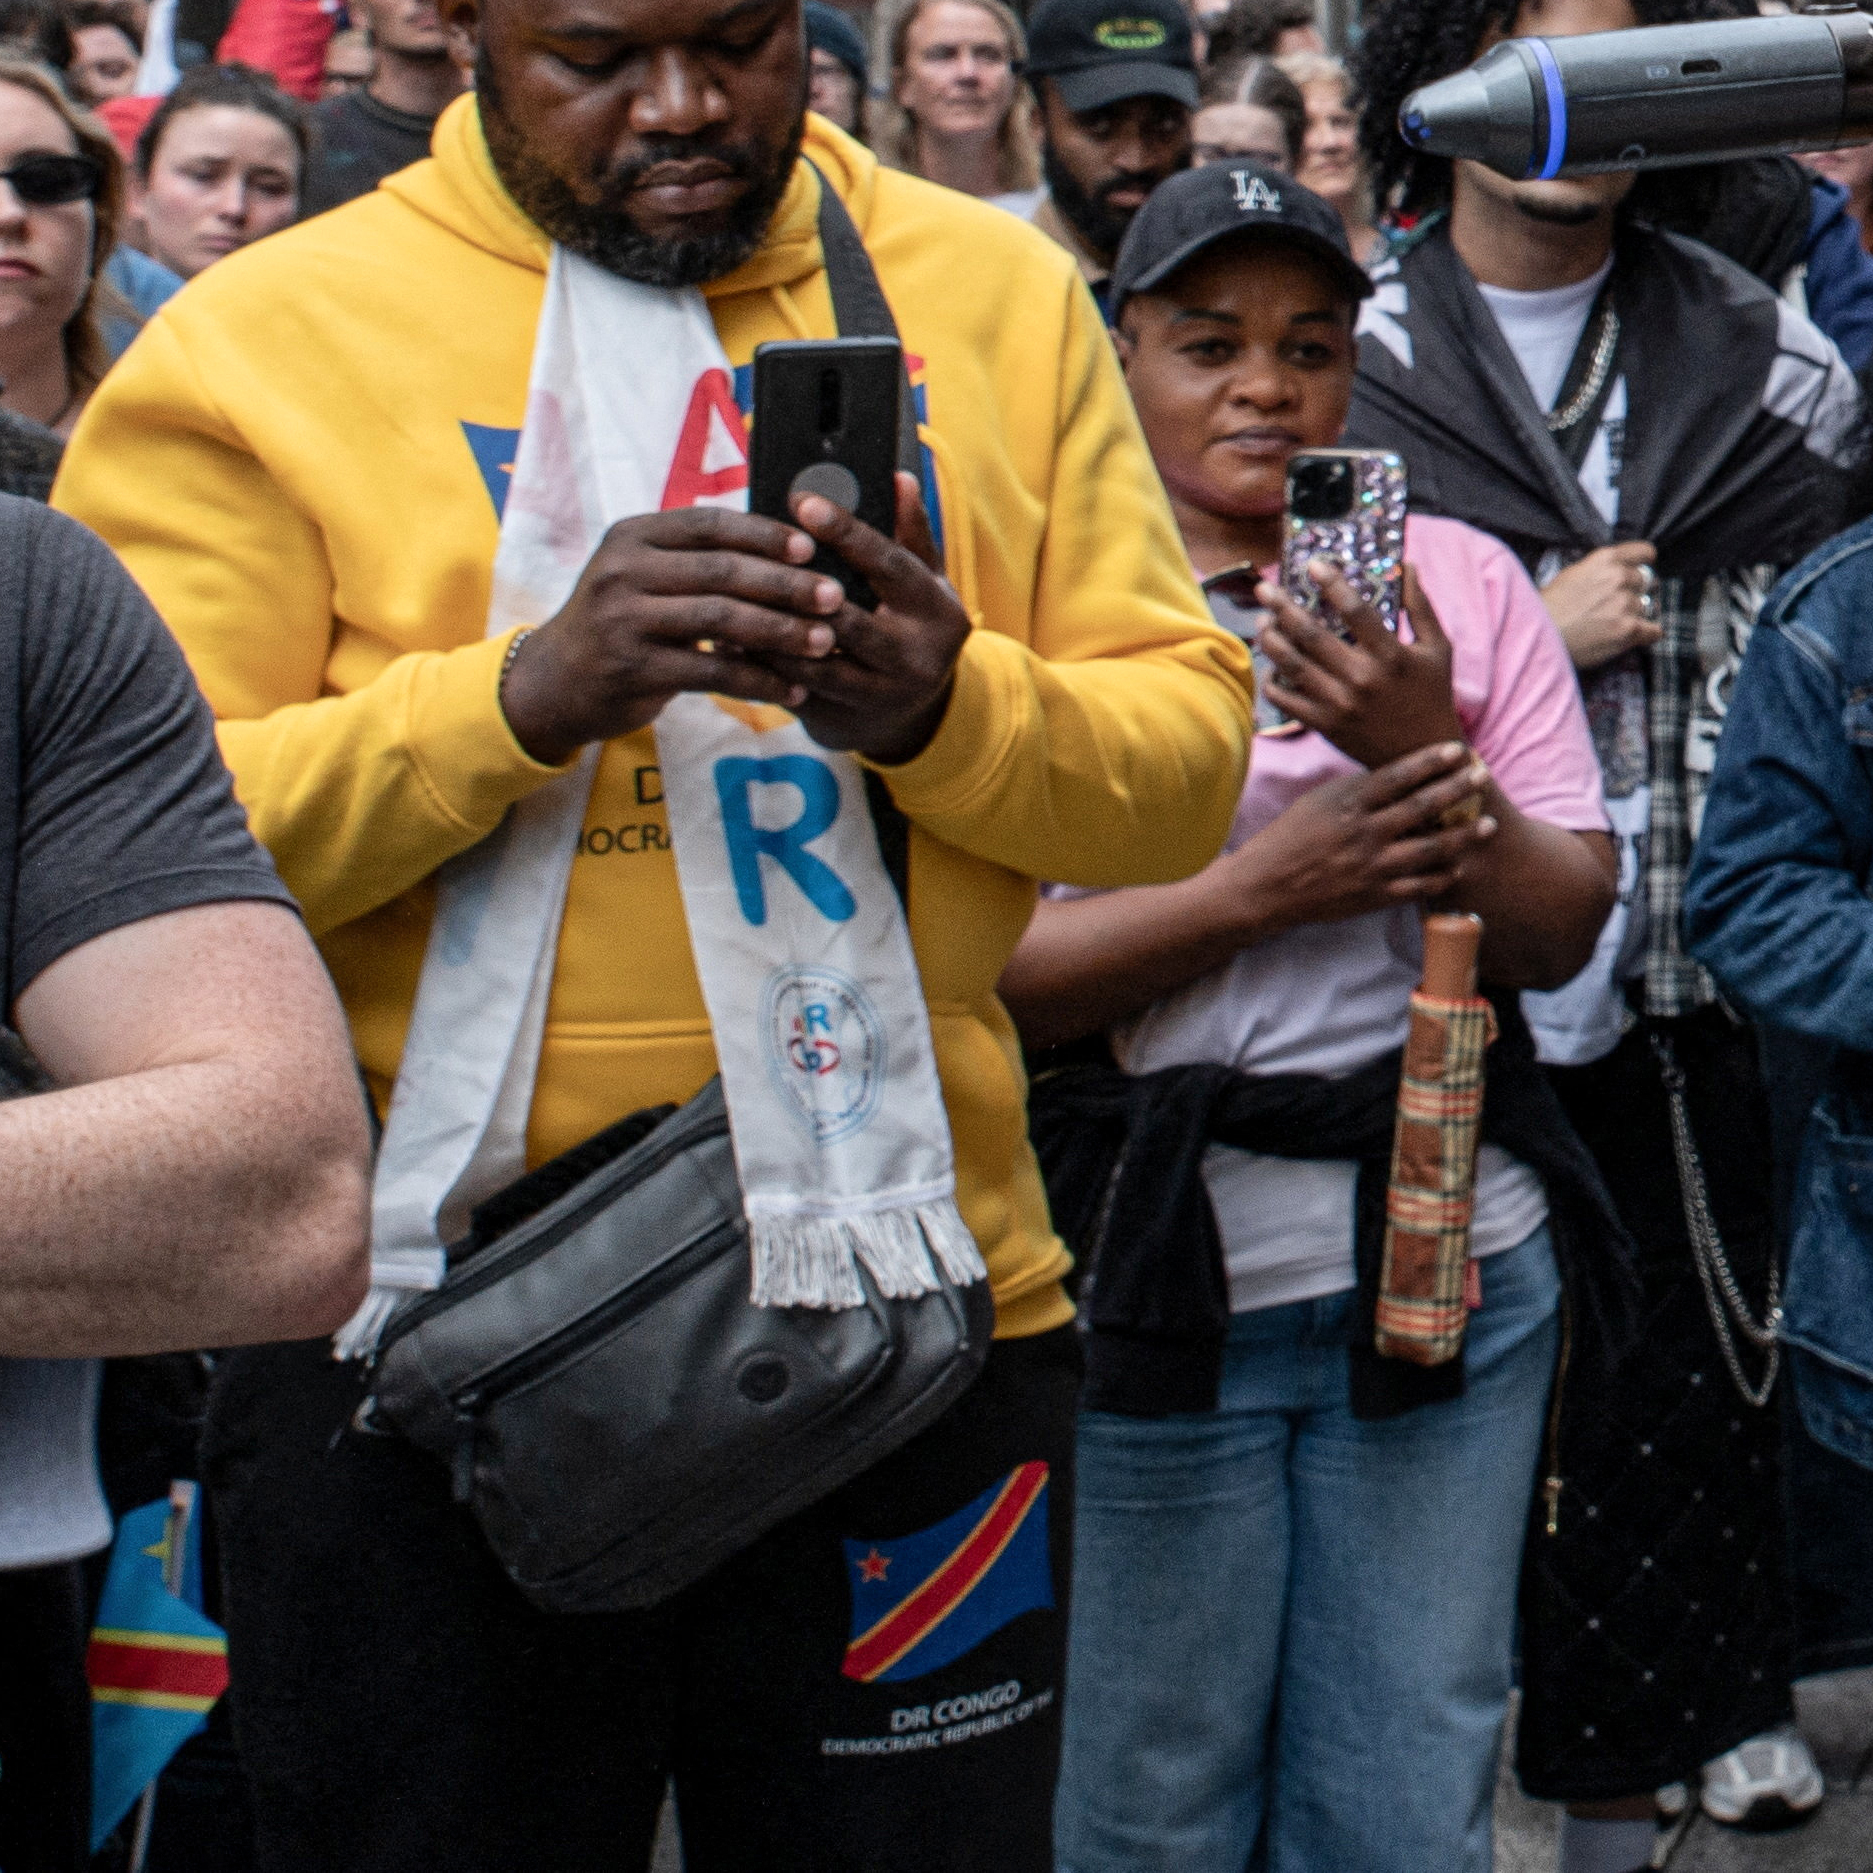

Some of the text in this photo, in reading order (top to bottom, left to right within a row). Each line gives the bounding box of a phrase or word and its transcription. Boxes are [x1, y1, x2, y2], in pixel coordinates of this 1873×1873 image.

[1230, 169, 1282, 213] LA
[713, 754, 856, 927] R
[889, 1679, 1021, 1733] DR CONGO
[821, 1729, 941, 1756] DEMOCRATIC
